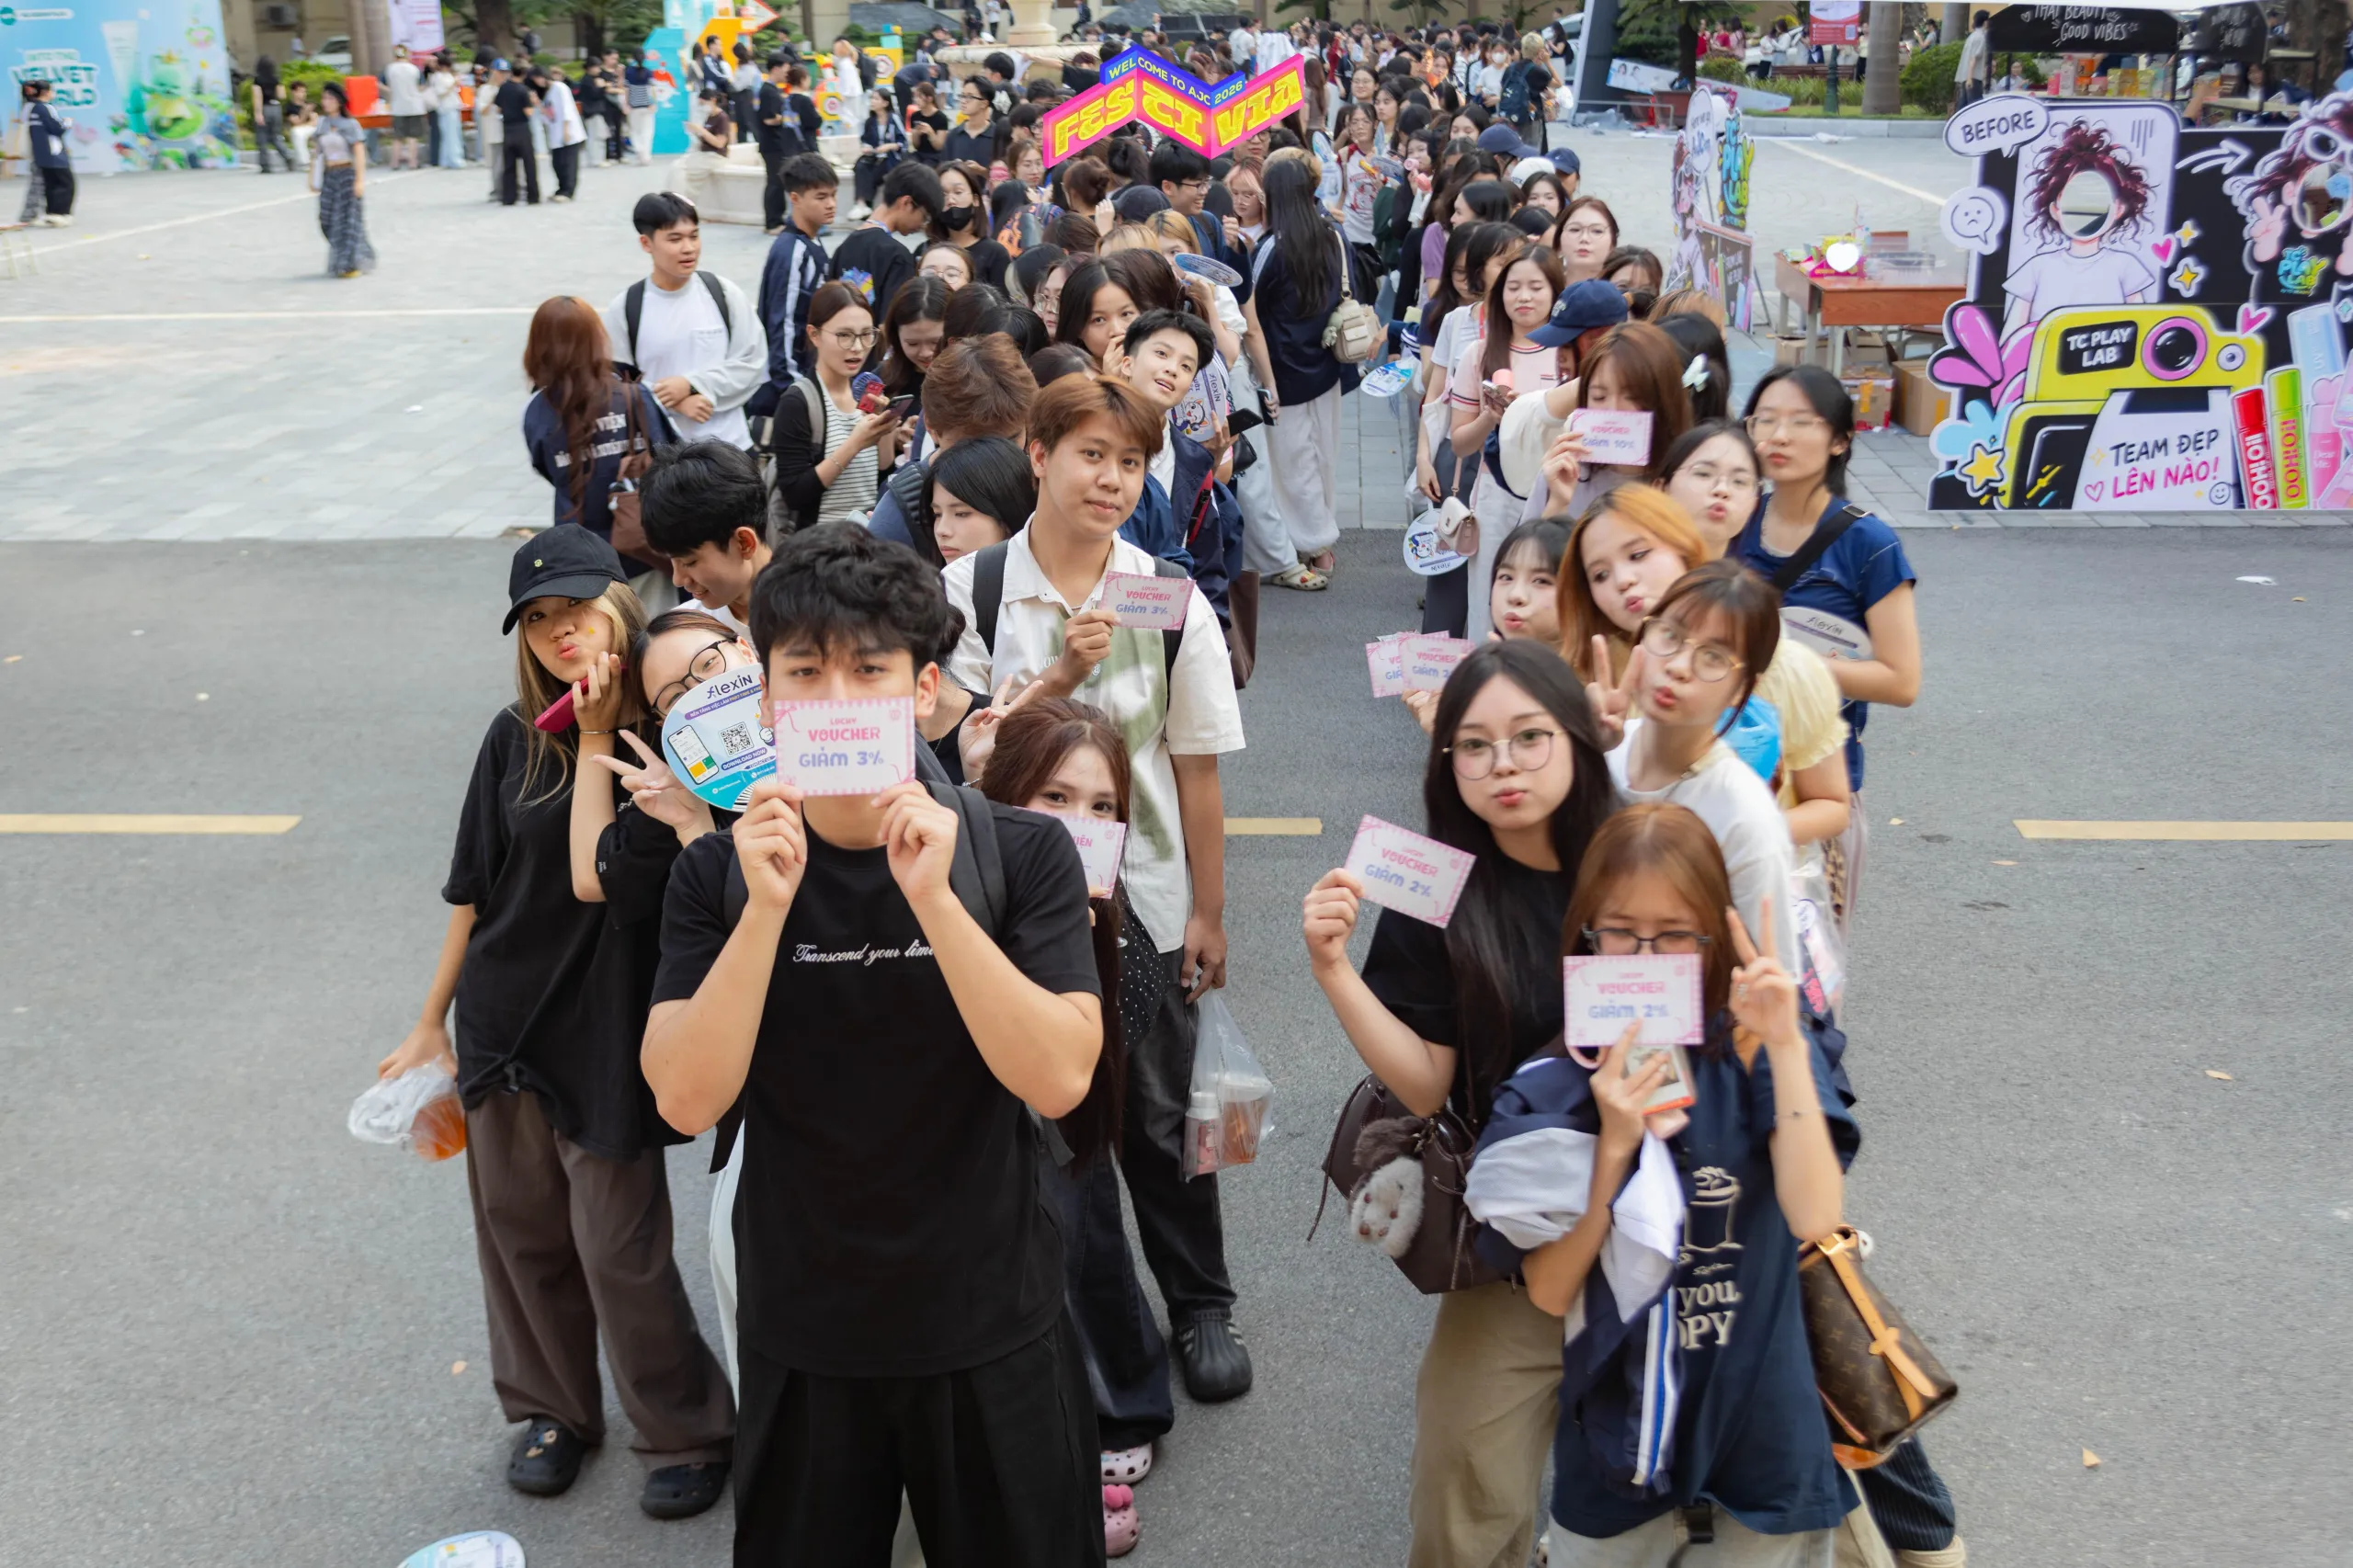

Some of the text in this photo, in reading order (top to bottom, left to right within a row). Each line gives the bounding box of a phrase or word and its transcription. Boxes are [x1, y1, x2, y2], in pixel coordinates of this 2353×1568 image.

[2060, 21, 2127, 41] GOOD VIBES
[1961, 110, 2035, 143] BEFORE
[2067, 327, 2132, 351] TC PLAY
[2081, 347, 2119, 368] LAB
[2109, 429, 2219, 467] TEAM ĐẸP
[2112, 457, 2220, 499] LÊN NÀO!
[1126, 590, 1172, 601] VOUCHER
[1116, 600, 1168, 615] GIẢM 3%
[1416, 652, 1457, 663] VOUCHER
[830, 717, 857, 725] LUCKY
[808, 727, 881, 742] VOUCHER
[722, 748, 766, 769] DOWNLOAD NOW
[799, 746, 884, 767] GIẢM 3%
[1381, 847, 1438, 877] VOUCHER
[1365, 864, 1434, 897] GIẢM 2%
[793, 943, 870, 962] Transcend
[864, 949, 900, 966] your
[1597, 982, 1665, 994] VOUCHER
[1588, 999, 1669, 1018] GIẢM 2%
